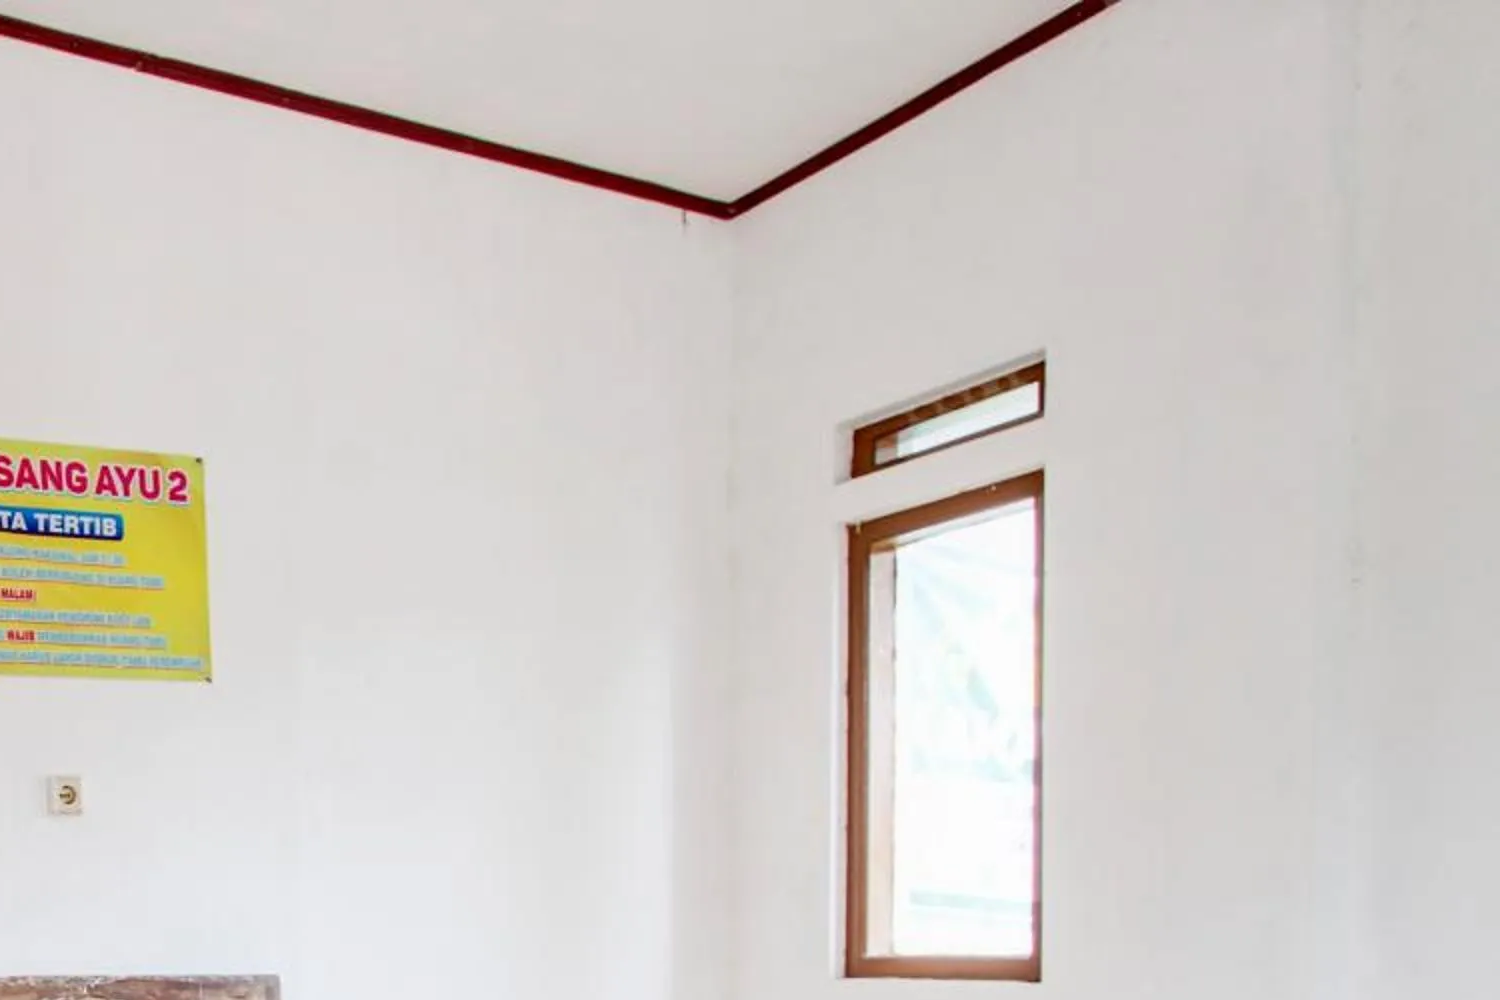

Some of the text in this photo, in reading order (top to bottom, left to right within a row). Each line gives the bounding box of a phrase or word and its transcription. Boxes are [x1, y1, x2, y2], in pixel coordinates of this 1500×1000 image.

[94, 464, 160, 500] AYU
[167, 470, 188, 502] 2
[32, 511, 117, 537] TERTIB
